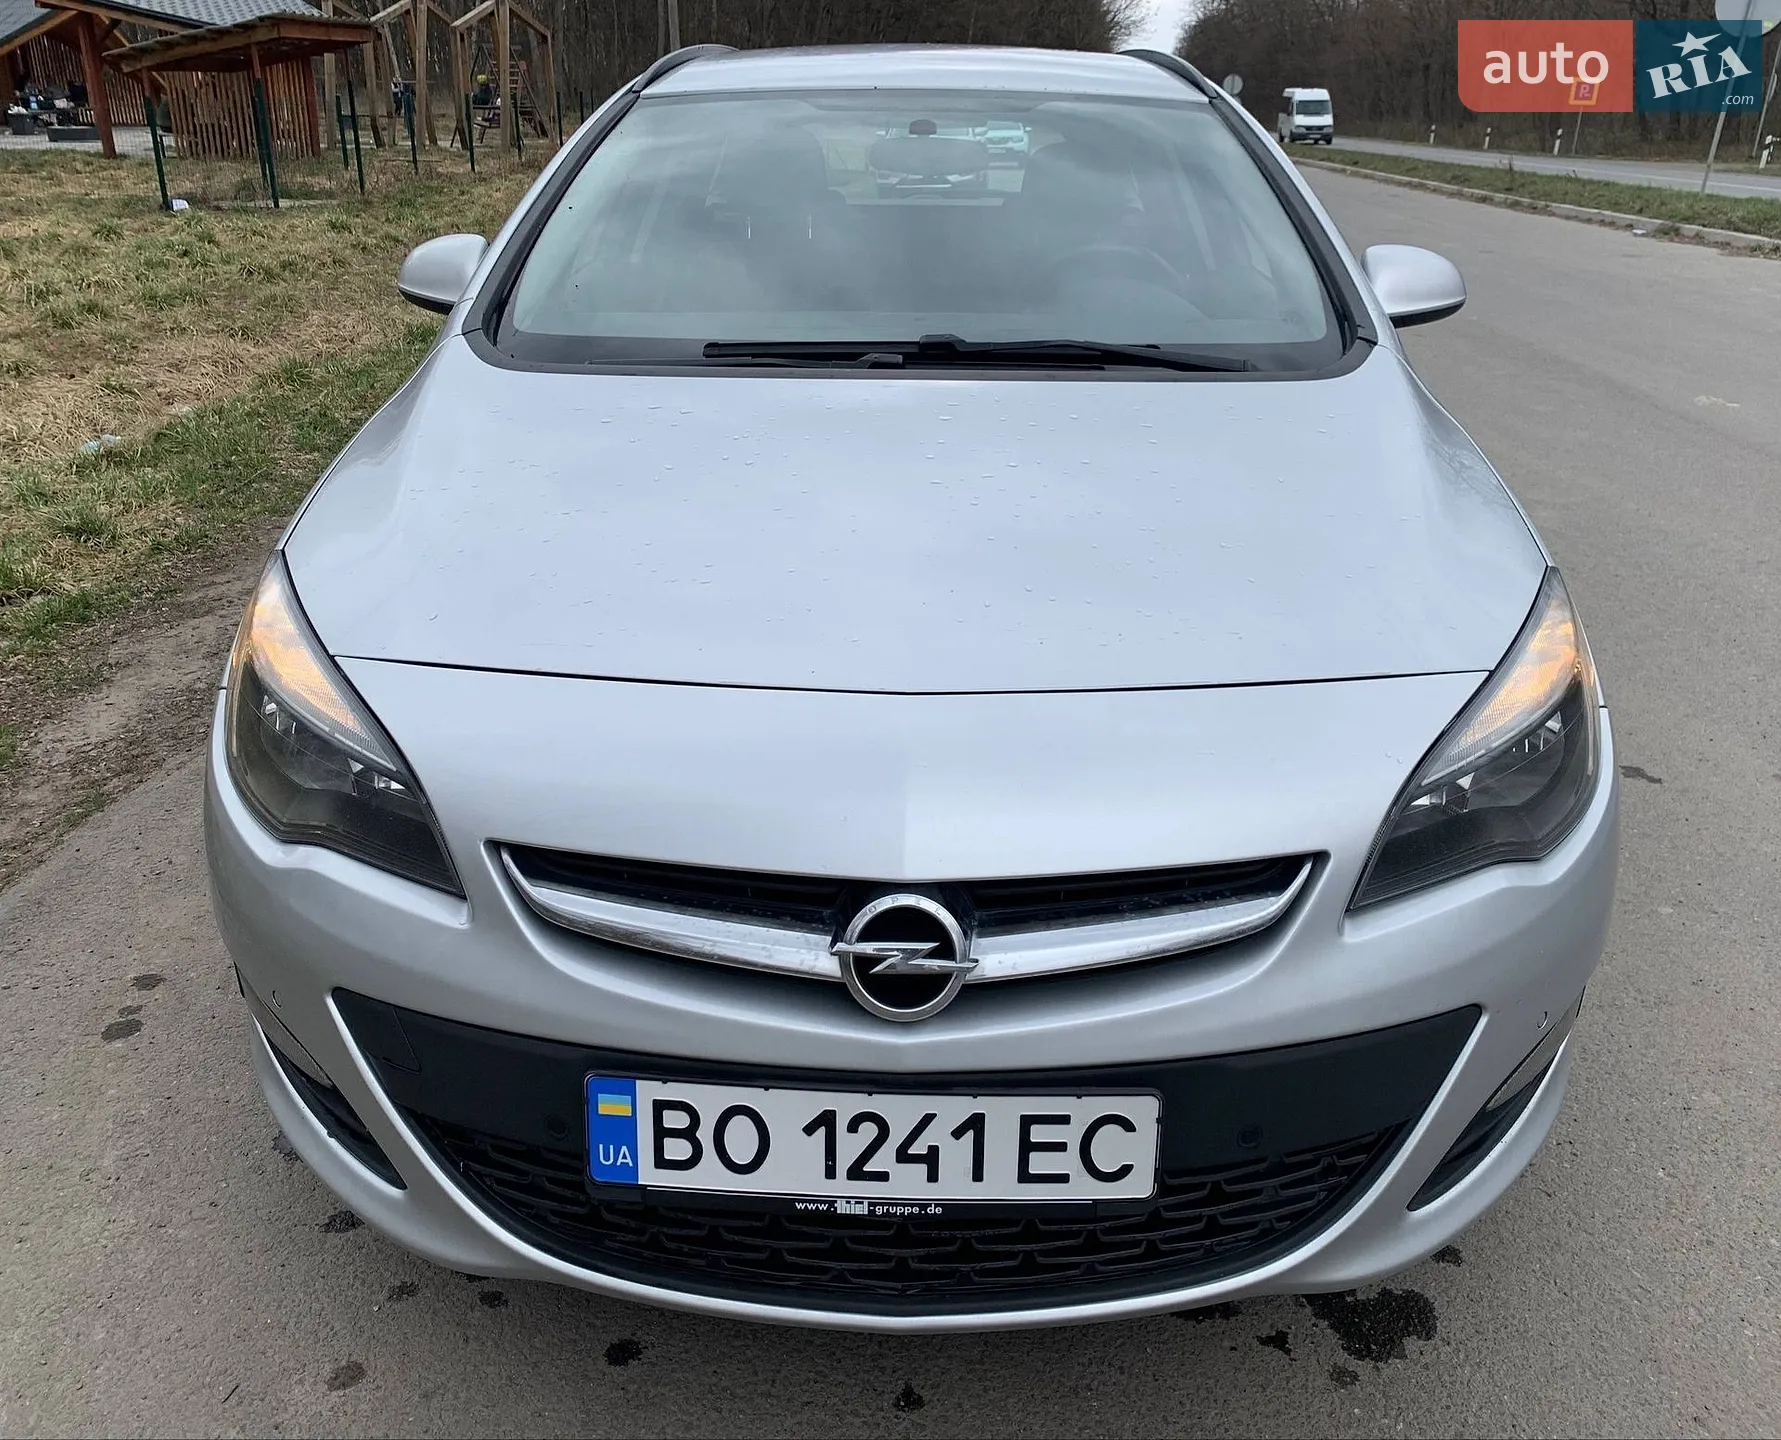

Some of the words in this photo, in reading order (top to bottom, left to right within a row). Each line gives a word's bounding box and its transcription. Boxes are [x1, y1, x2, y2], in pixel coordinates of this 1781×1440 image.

[867, 896, 942, 916] OPEL
[652, 1098, 772, 1176] BO
[802, 1108, 986, 1184] 1241
[1017, 1112, 1138, 1184] EC
[599, 1143, 634, 1168] UA
